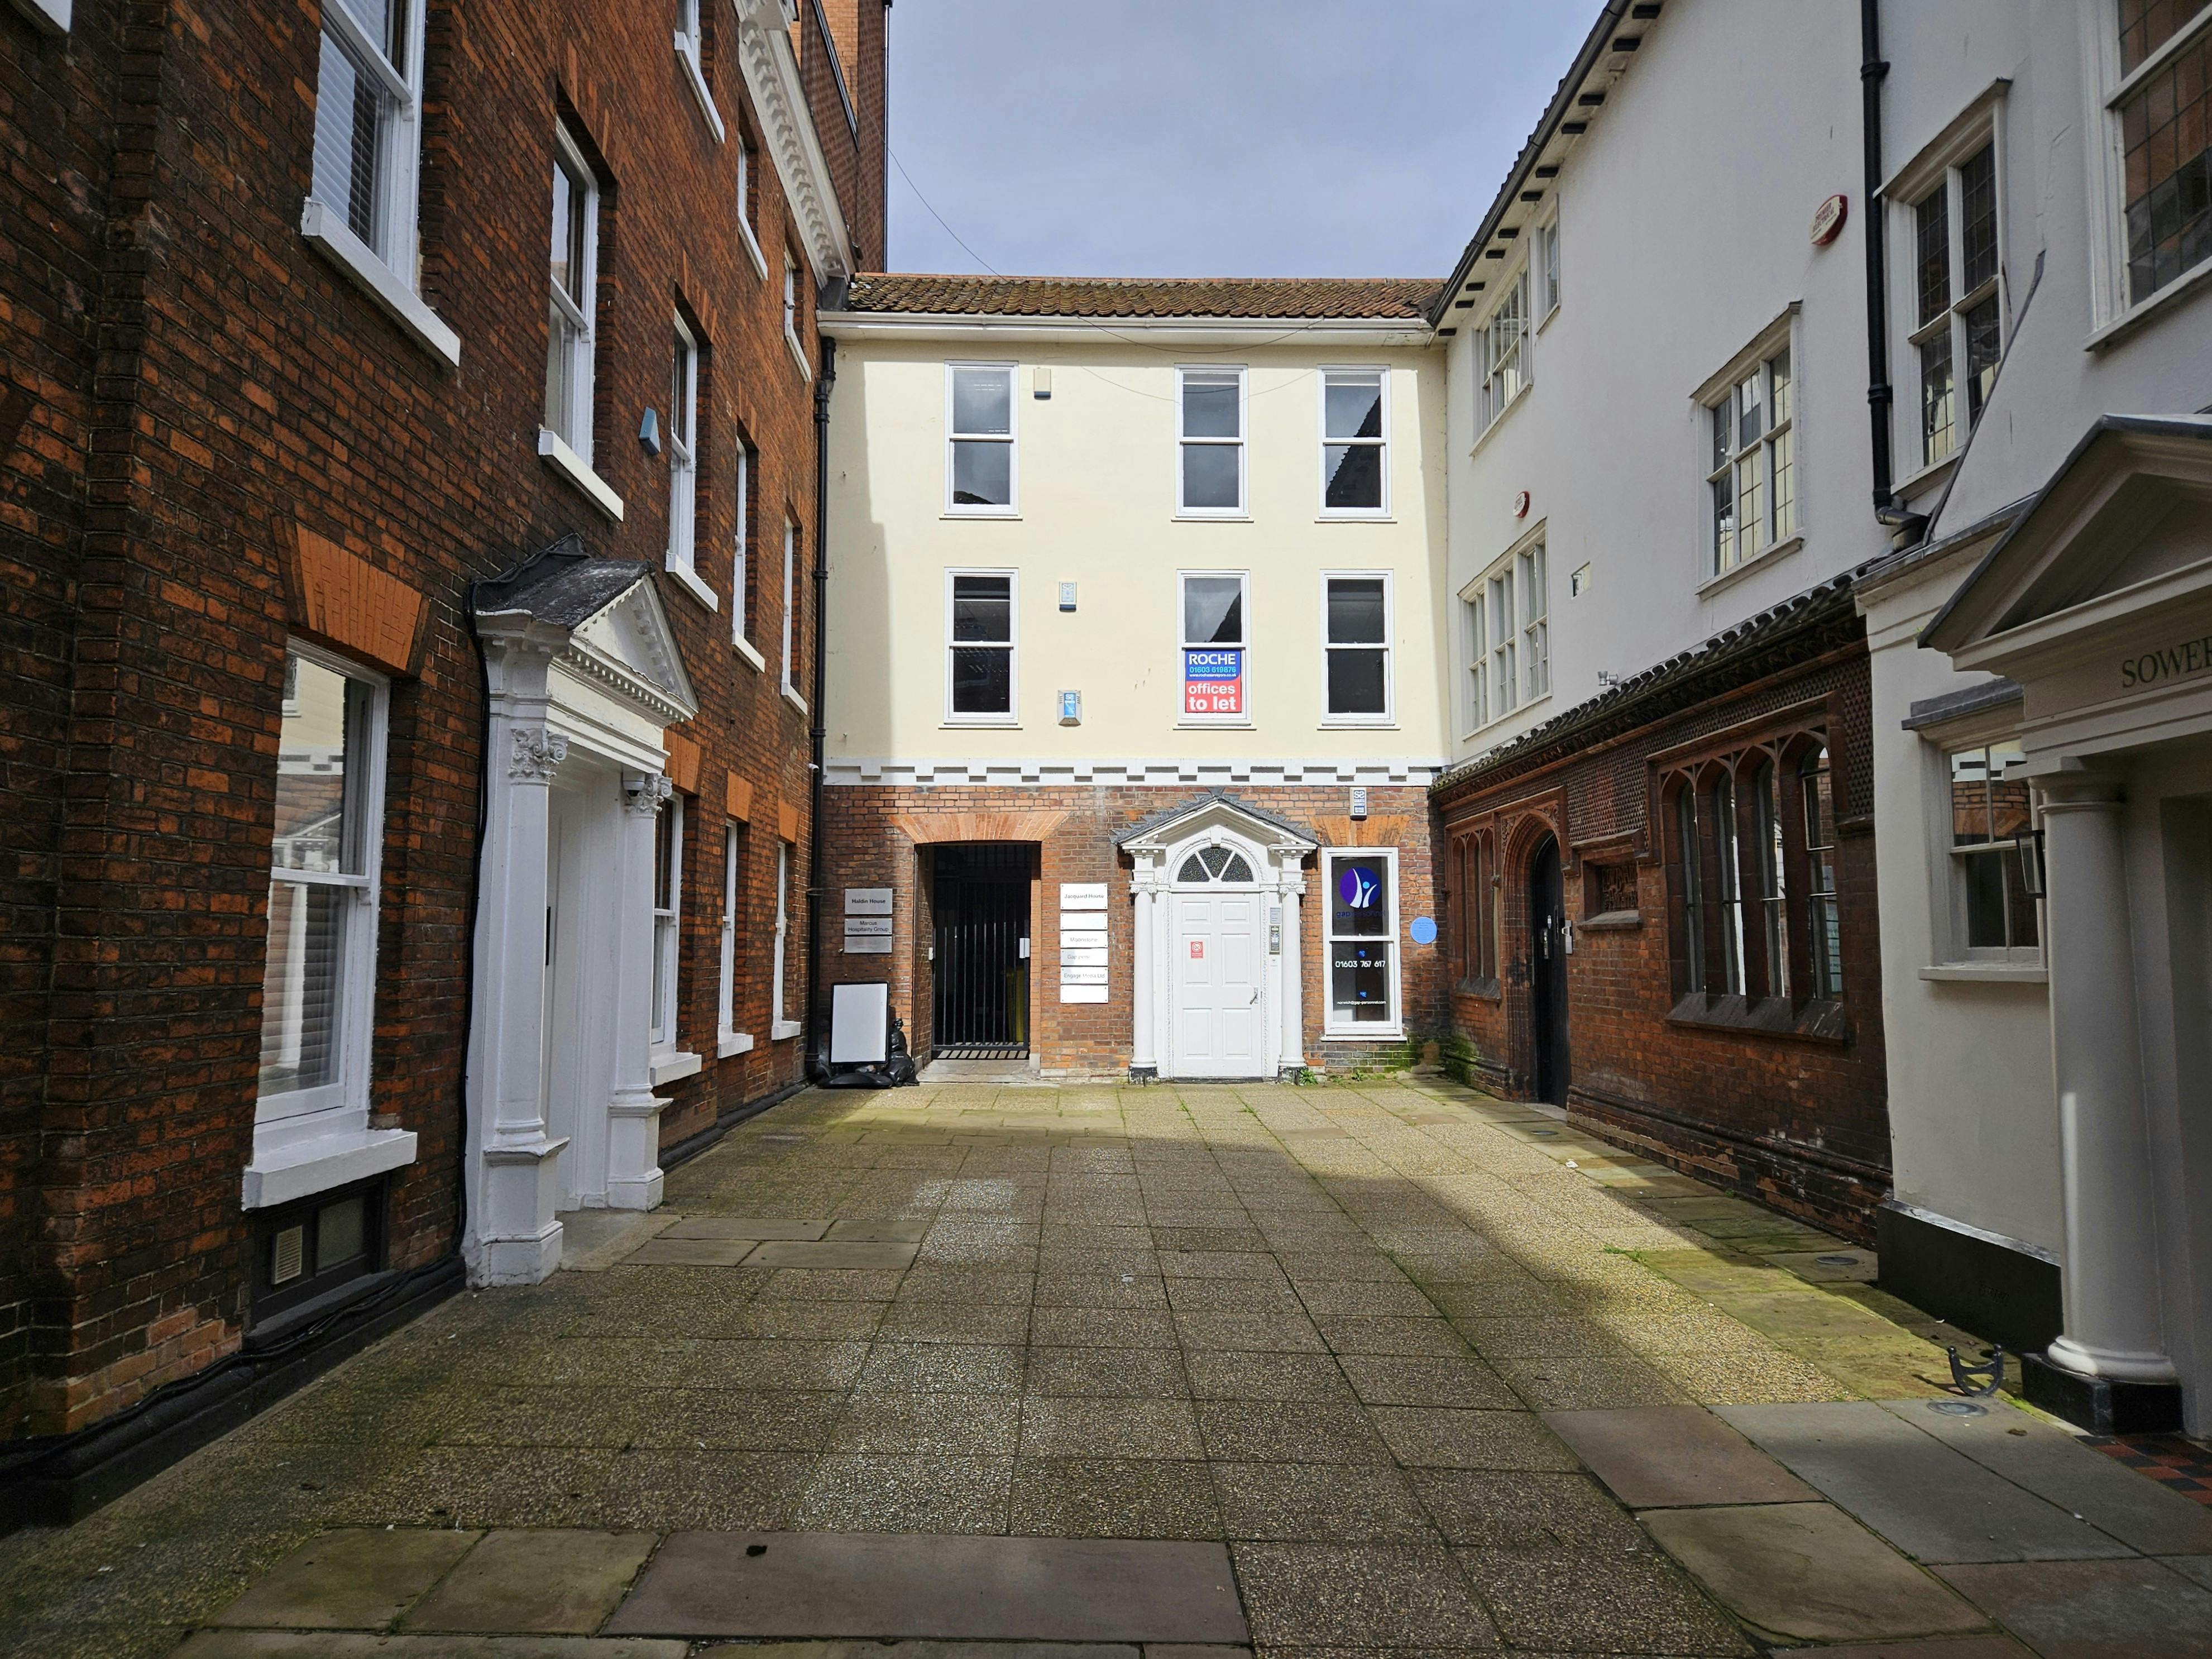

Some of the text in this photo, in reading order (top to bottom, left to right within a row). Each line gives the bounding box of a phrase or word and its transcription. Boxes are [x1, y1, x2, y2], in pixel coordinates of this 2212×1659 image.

[1189, 653, 1236, 665] ROCHE
[1188, 683, 1236, 694] offices
[1189, 696, 1236, 710] to let
